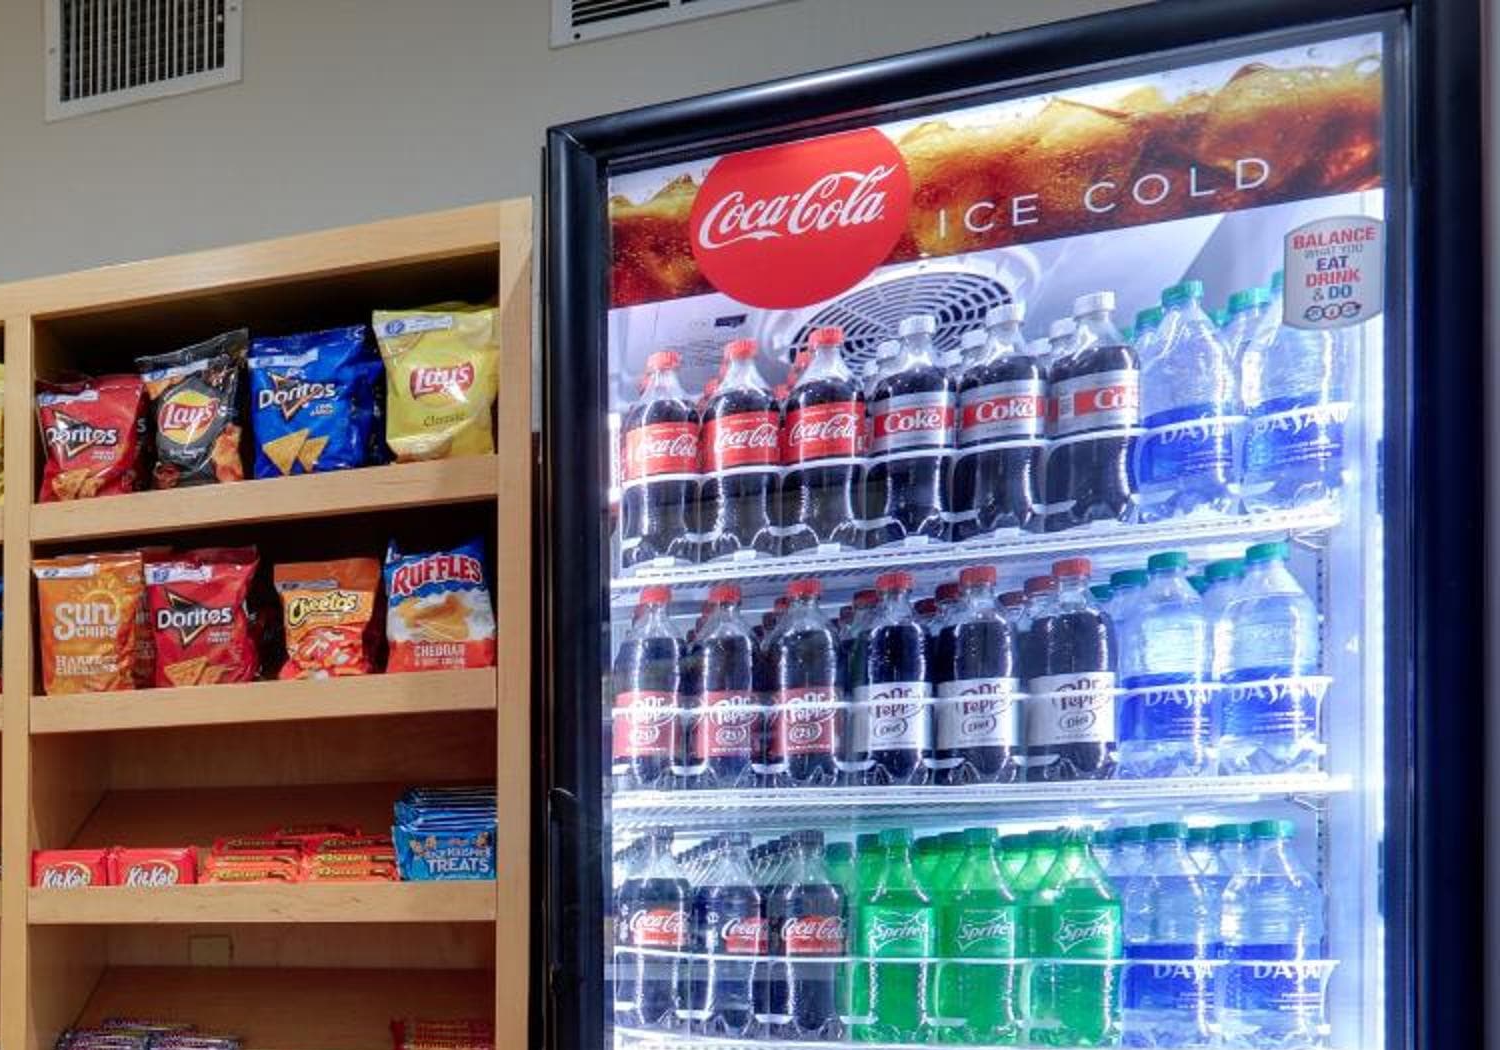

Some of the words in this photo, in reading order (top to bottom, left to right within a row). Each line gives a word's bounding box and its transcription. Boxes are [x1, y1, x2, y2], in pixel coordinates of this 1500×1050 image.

[699, 164, 897, 251] Coca-Cola
[937, 193, 1040, 240] ICE
[1084, 158, 1271, 215] COLD
[1292, 226, 1377, 250] BALANCE
[1305, 246, 1336, 259] WHAT
[1341, 244, 1364, 254] YOU
[1316, 255, 1349, 272] EAT
[1305, 268, 1361, 288] DRINK
[1312, 287, 1325, 302] &
[1328, 284, 1353, 299] DO
[259, 380, 336, 410] Doritos
[1094, 386, 1137, 411] Co
[164, 401, 214, 431] Lay's
[975, 396, 1037, 423] Coke
[789, 413, 859, 447] Coca-Cola
[884, 408, 942, 434] Coke
[46, 426, 117, 446] Doritos
[638, 434, 697, 458] oca-Cola
[390, 553, 483, 595] RUFFLES
[157, 606, 232, 629] Doritos
[287, 590, 358, 626] Cheetos
[55, 602, 120, 641] Sun
[75, 624, 118, 638] CHIPS
[414, 642, 466, 657] CHEDDAR
[890, 687, 912, 700] Dr
[979, 683, 1001, 696] Dr
[1076, 677, 1101, 692] Dr
[731, 695, 751, 707] Dr
[805, 692, 825, 705] Dr
[1067, 714, 1090, 729] Diet
[426, 857, 490, 874] TREATS
[958, 923, 1014, 941] Sprite
